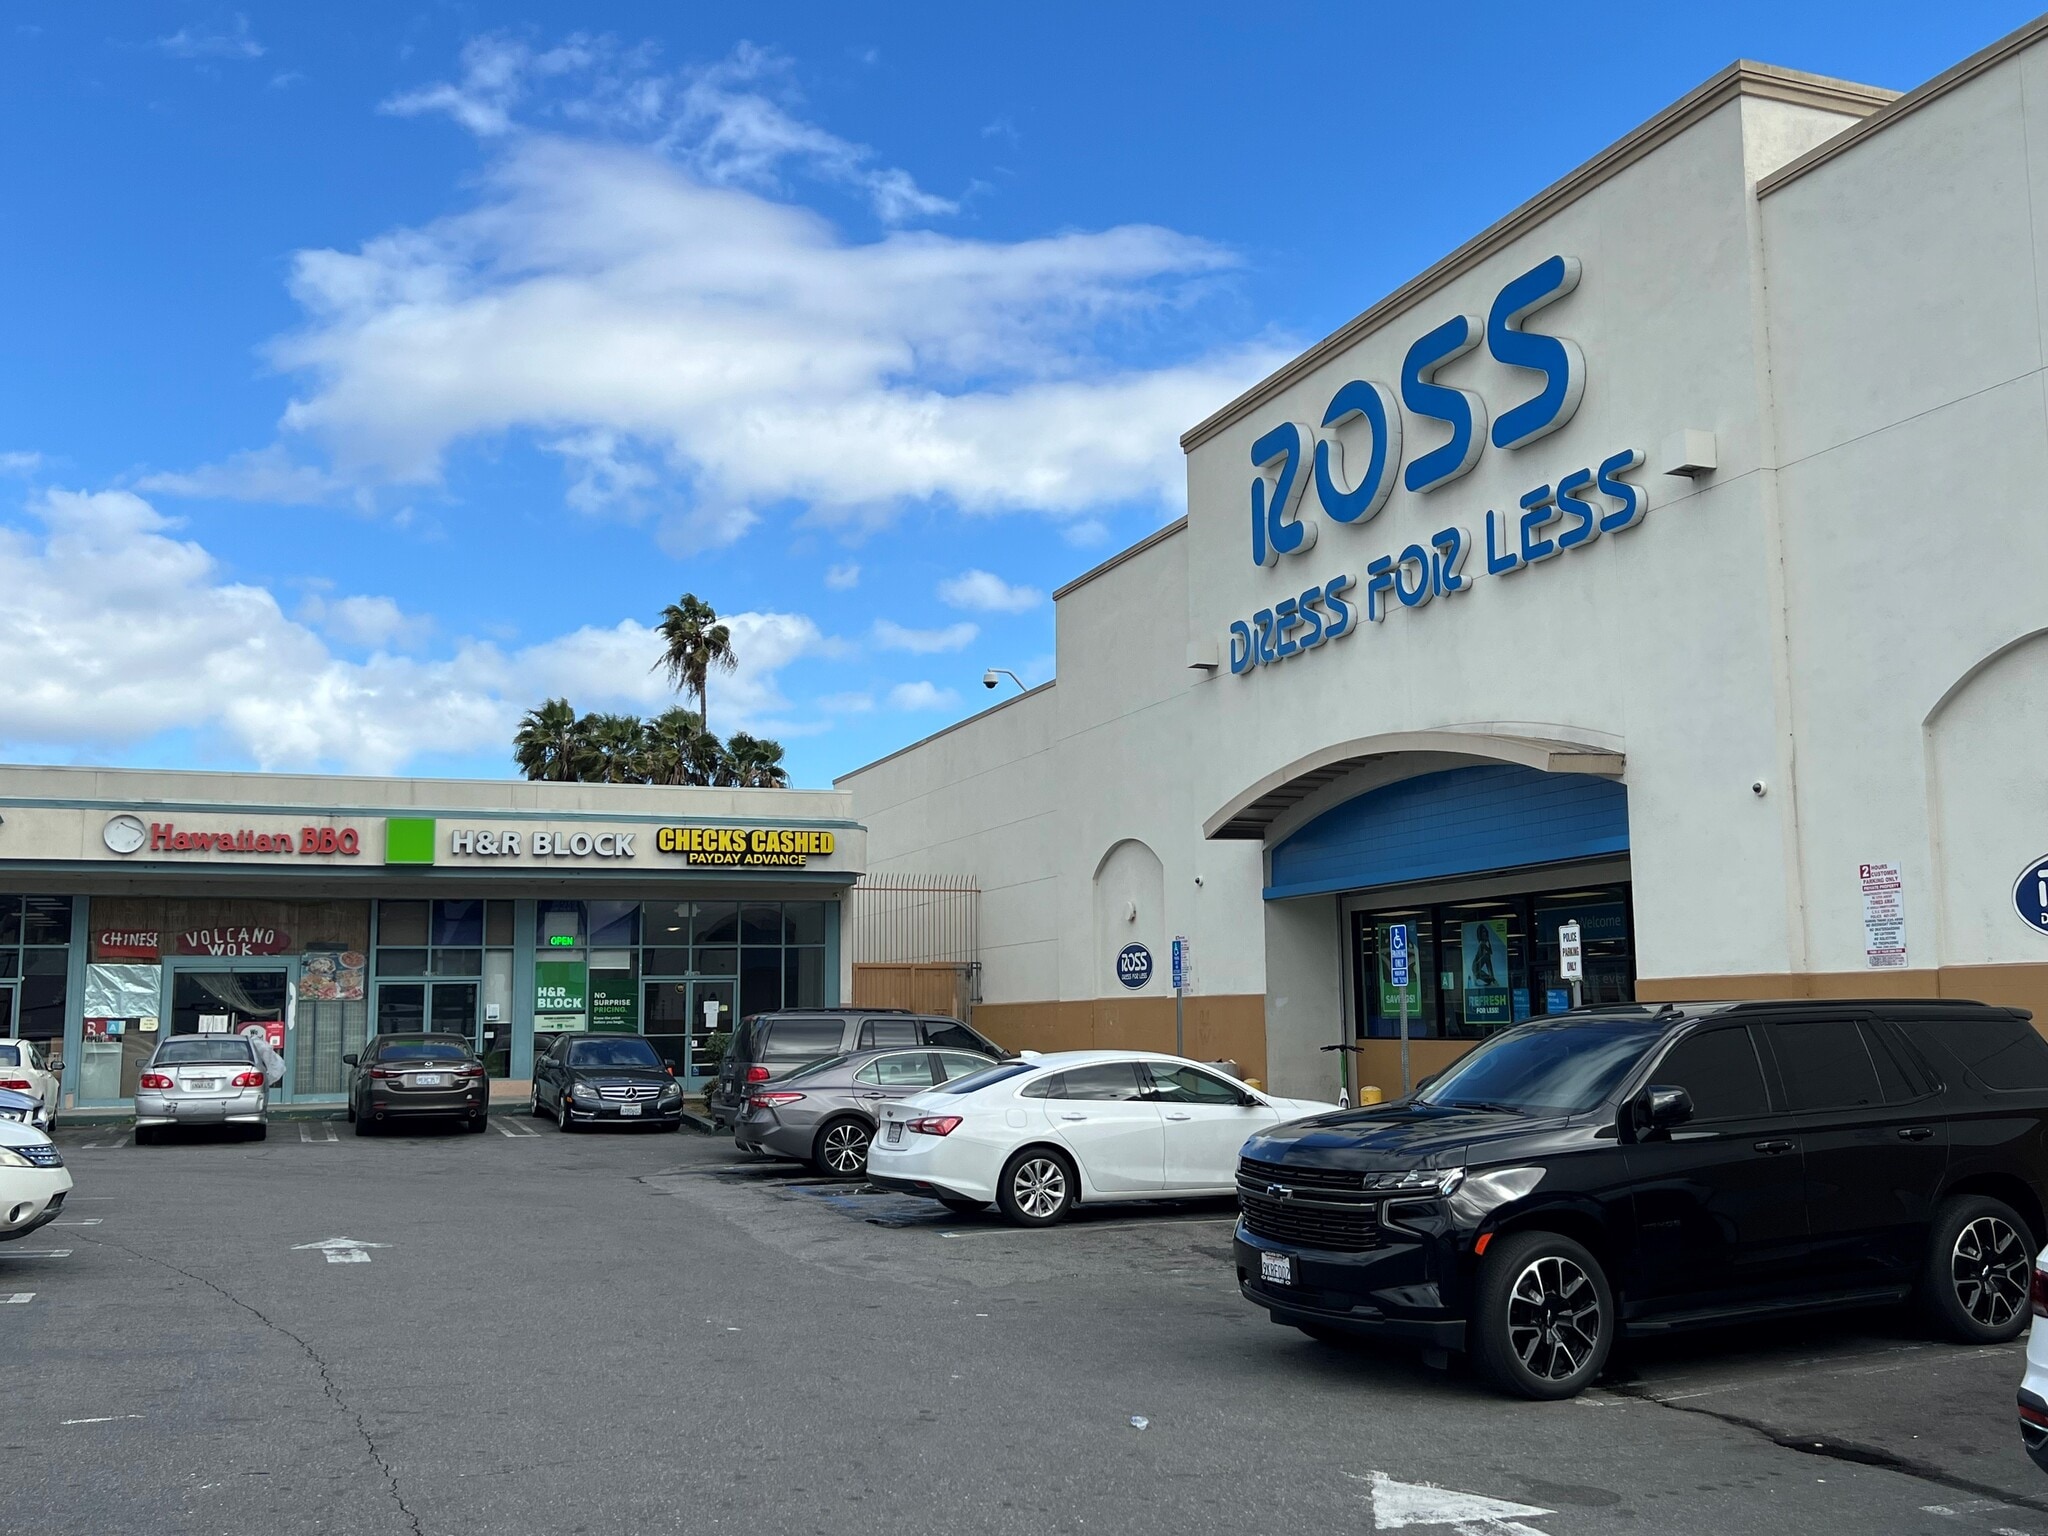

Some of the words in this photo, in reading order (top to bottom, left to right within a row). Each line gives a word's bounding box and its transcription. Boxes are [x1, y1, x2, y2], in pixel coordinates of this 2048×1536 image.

[1251, 255, 1586, 567] ROSS
[1230, 574, 1357, 675] DRESS
[1368, 527, 1472, 623] FOR
[1486, 448, 1648, 576] LESS
[151, 823, 293, 852] Hawaiian
[300, 828, 360, 855] BBQ
[452, 830, 521, 856] H&R
[532, 832, 636, 857] BLOCK
[657, 828, 746, 852] CHECKS
[751, 831, 835, 855] CASHED
[689, 853, 741, 865] PAYDAY
[744, 854, 806, 866] ADVANCE
[1862, 865, 1869, 877] 2
[102, 932, 158, 947] CHINESE
[186, 928, 275, 947] VOLCANO
[550, 936, 574, 946] OPEN
[1563, 932, 1577, 942] POLICE
[208, 944, 252, 956] WOK
[1563, 947, 1579, 957] PARKING
[1121, 952, 1147, 972] ROSS
[538, 987, 566, 997] H&R
[538, 998, 582, 1008] BLOCK
[1469, 995, 1507, 1006] REFRESH
[108, 1024, 117, 1032] A
